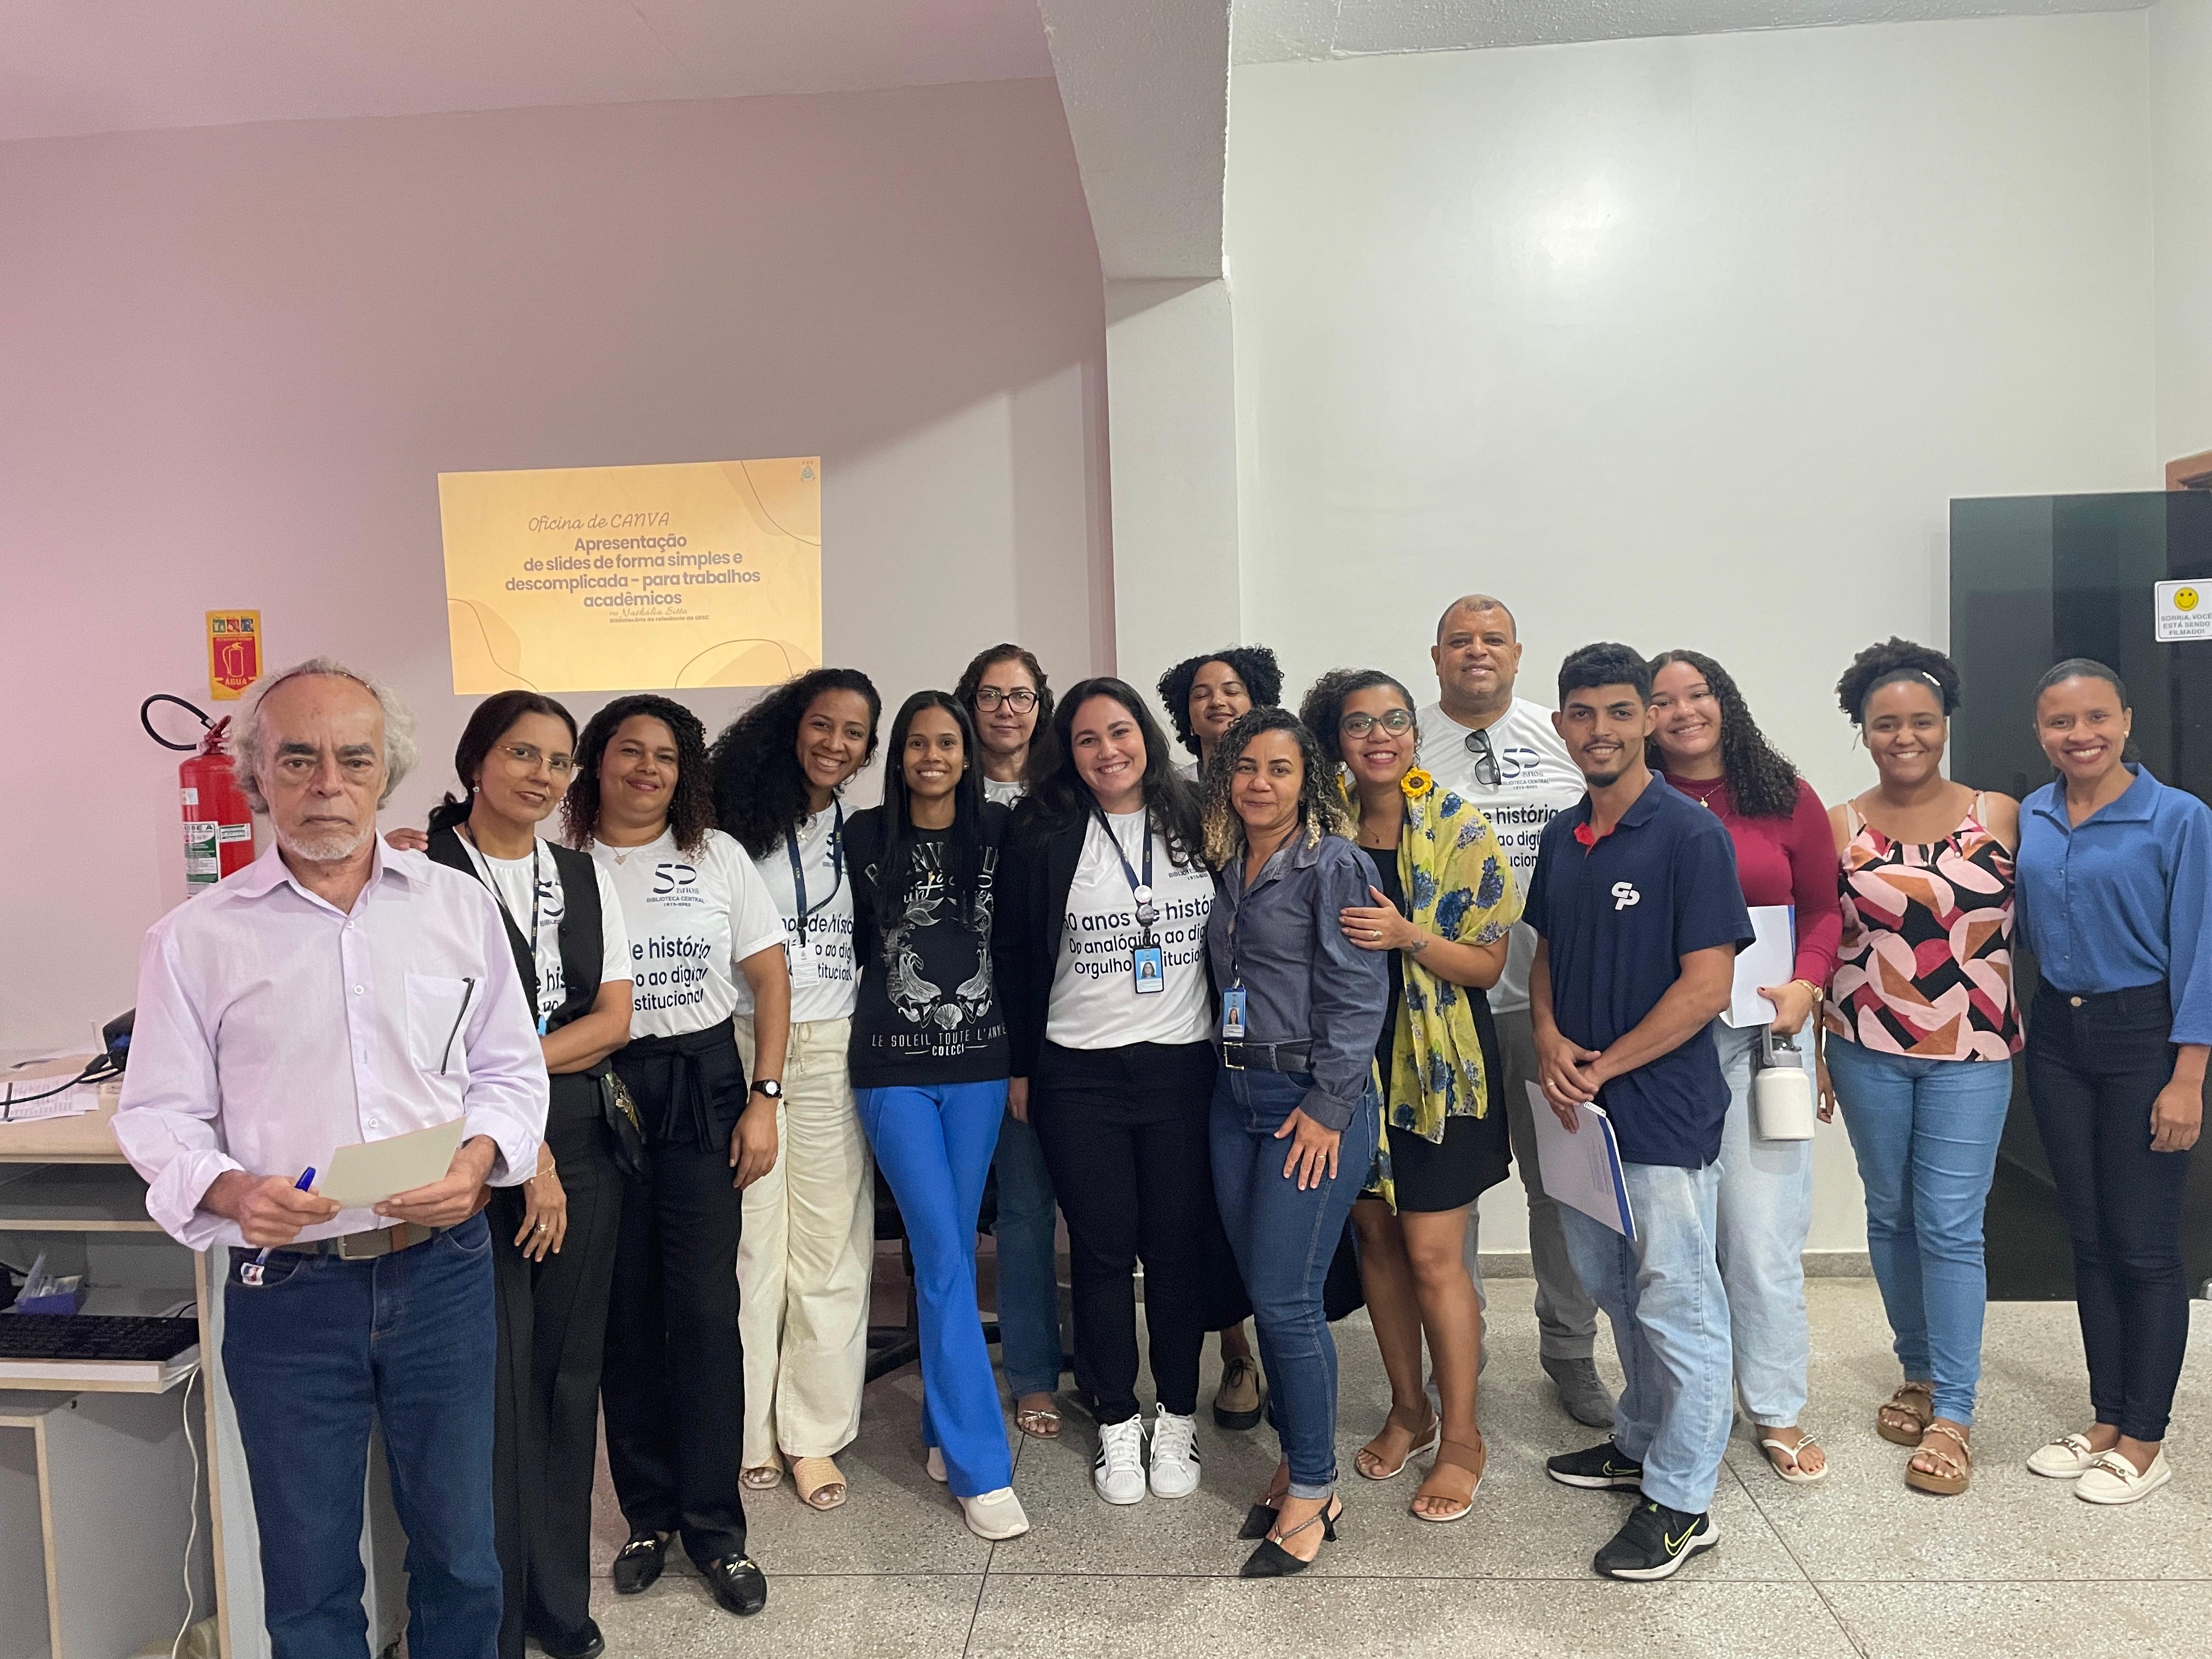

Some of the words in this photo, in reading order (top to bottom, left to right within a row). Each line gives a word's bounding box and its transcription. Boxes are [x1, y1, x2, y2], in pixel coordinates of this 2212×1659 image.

[528, 515, 583, 532] Oficina
[588, 514, 607, 528] de
[611, 512, 670, 528] CANVA
[574, 533, 687, 555] Apresentação
[523, 557, 543, 571] de
[546, 556, 591, 571] slides
[593, 555, 613, 569] de
[616, 554, 665, 568] forma
[667, 551, 730, 570] simples
[733, 552, 743, 563] e
[505, 573, 628, 594] descomplicada
[642, 574, 680, 591] para
[682, 569, 761, 585] trabalhos
[583, 590, 682, 607] acadêmicos
[2163, 620, 2182, 629] ESTÁ
[1496, 804, 1559, 825] história
[1497, 834, 1514, 847] ao
[1517, 830, 1541, 851] digi
[808, 913, 827, 932] de
[1082, 913, 1130, 931] anos
[628, 939, 644, 960] e
[649, 935, 711, 959] história
[825, 944, 836, 957] ao
[1085, 932, 1161, 954] analógio
[1165, 930, 1184, 944] ao
[649, 971, 667, 986] ao
[634, 988, 703, 1011] stitucional
[872, 1035, 883, 1047] LE
[891, 1034, 931, 1047] SOLEIL
[939, 1030, 970, 1045] TOUTE
[932, 1043, 964, 1056] COLCCI
